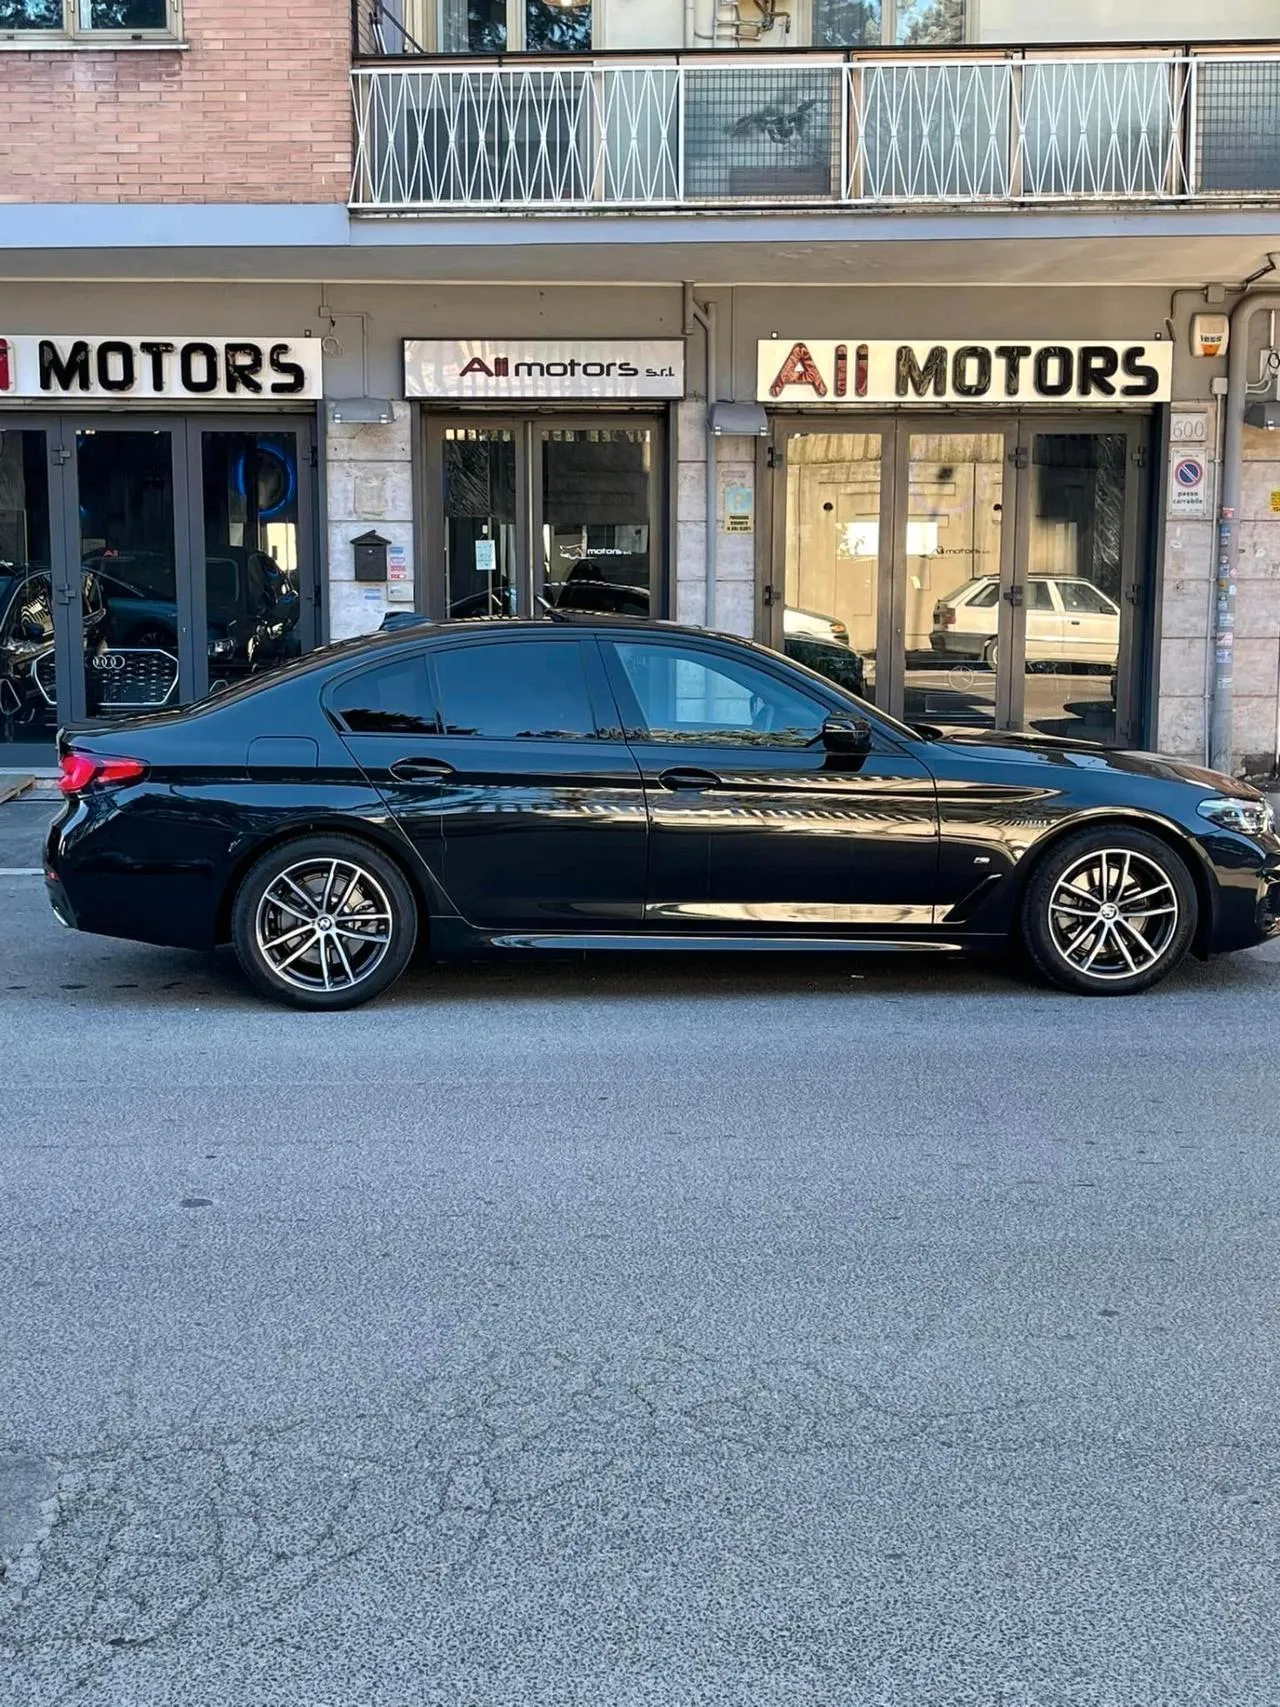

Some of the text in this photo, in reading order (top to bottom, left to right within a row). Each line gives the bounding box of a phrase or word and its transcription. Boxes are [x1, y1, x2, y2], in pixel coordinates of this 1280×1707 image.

[39, 340, 305, 393] MOTORS
[459, 357, 509, 377] All
[514, 359, 639, 377] motors
[769, 342, 1160, 397] All MOTORS
[1173, 421, 1204, 438] 600
